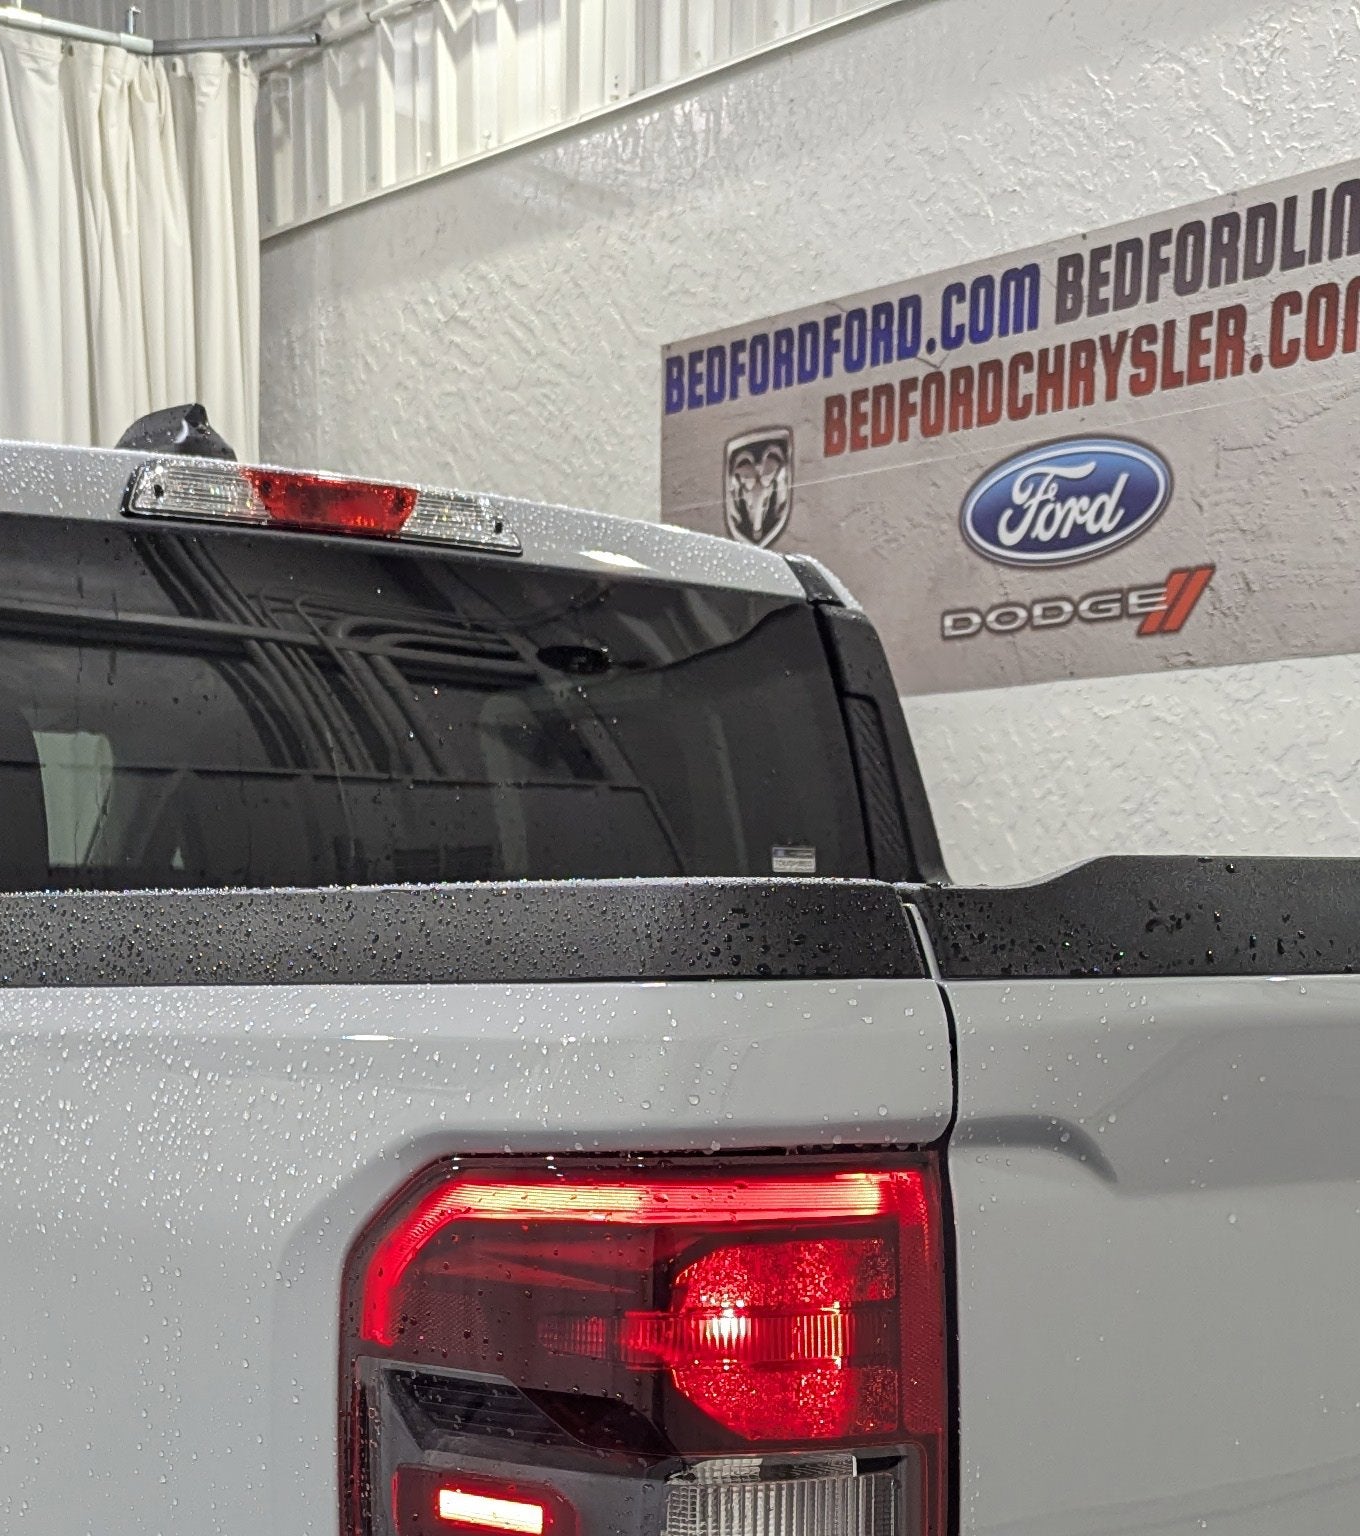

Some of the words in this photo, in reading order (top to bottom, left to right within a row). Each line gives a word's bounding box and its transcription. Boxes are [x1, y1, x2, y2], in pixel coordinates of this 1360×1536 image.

[664, 264, 1040, 415] BEDFORDFORD.COM
[997, 461, 1130, 547] Ford
[942, 583, 1168, 639] DODGE
